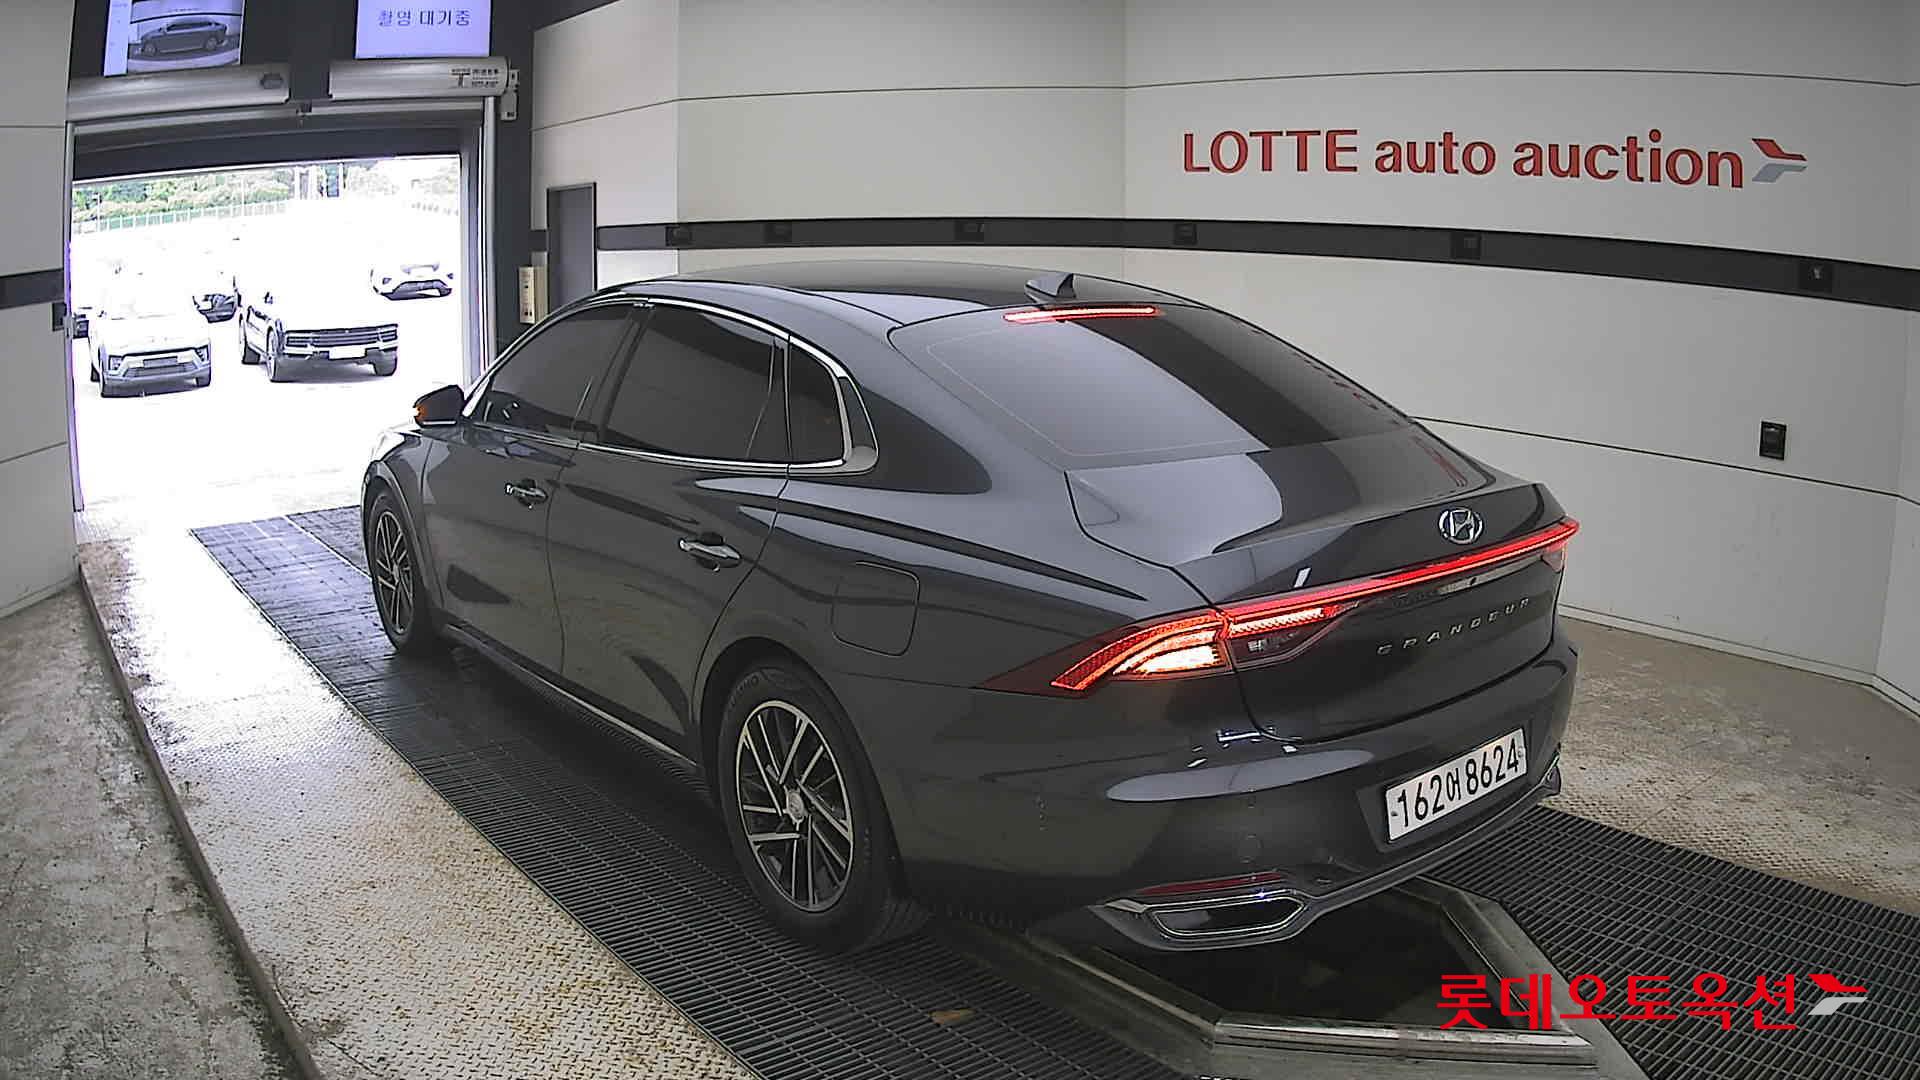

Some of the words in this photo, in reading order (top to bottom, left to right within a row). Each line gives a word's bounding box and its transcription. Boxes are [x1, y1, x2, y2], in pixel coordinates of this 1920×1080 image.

[419, 10, 470, 26] 대기중
[1184, 129, 1358, 173] LOTTE
[1375, 131, 1496, 175] auto
[1513, 129, 1743, 188] auction
[1376, 597, 1530, 655] GRANDEUR
